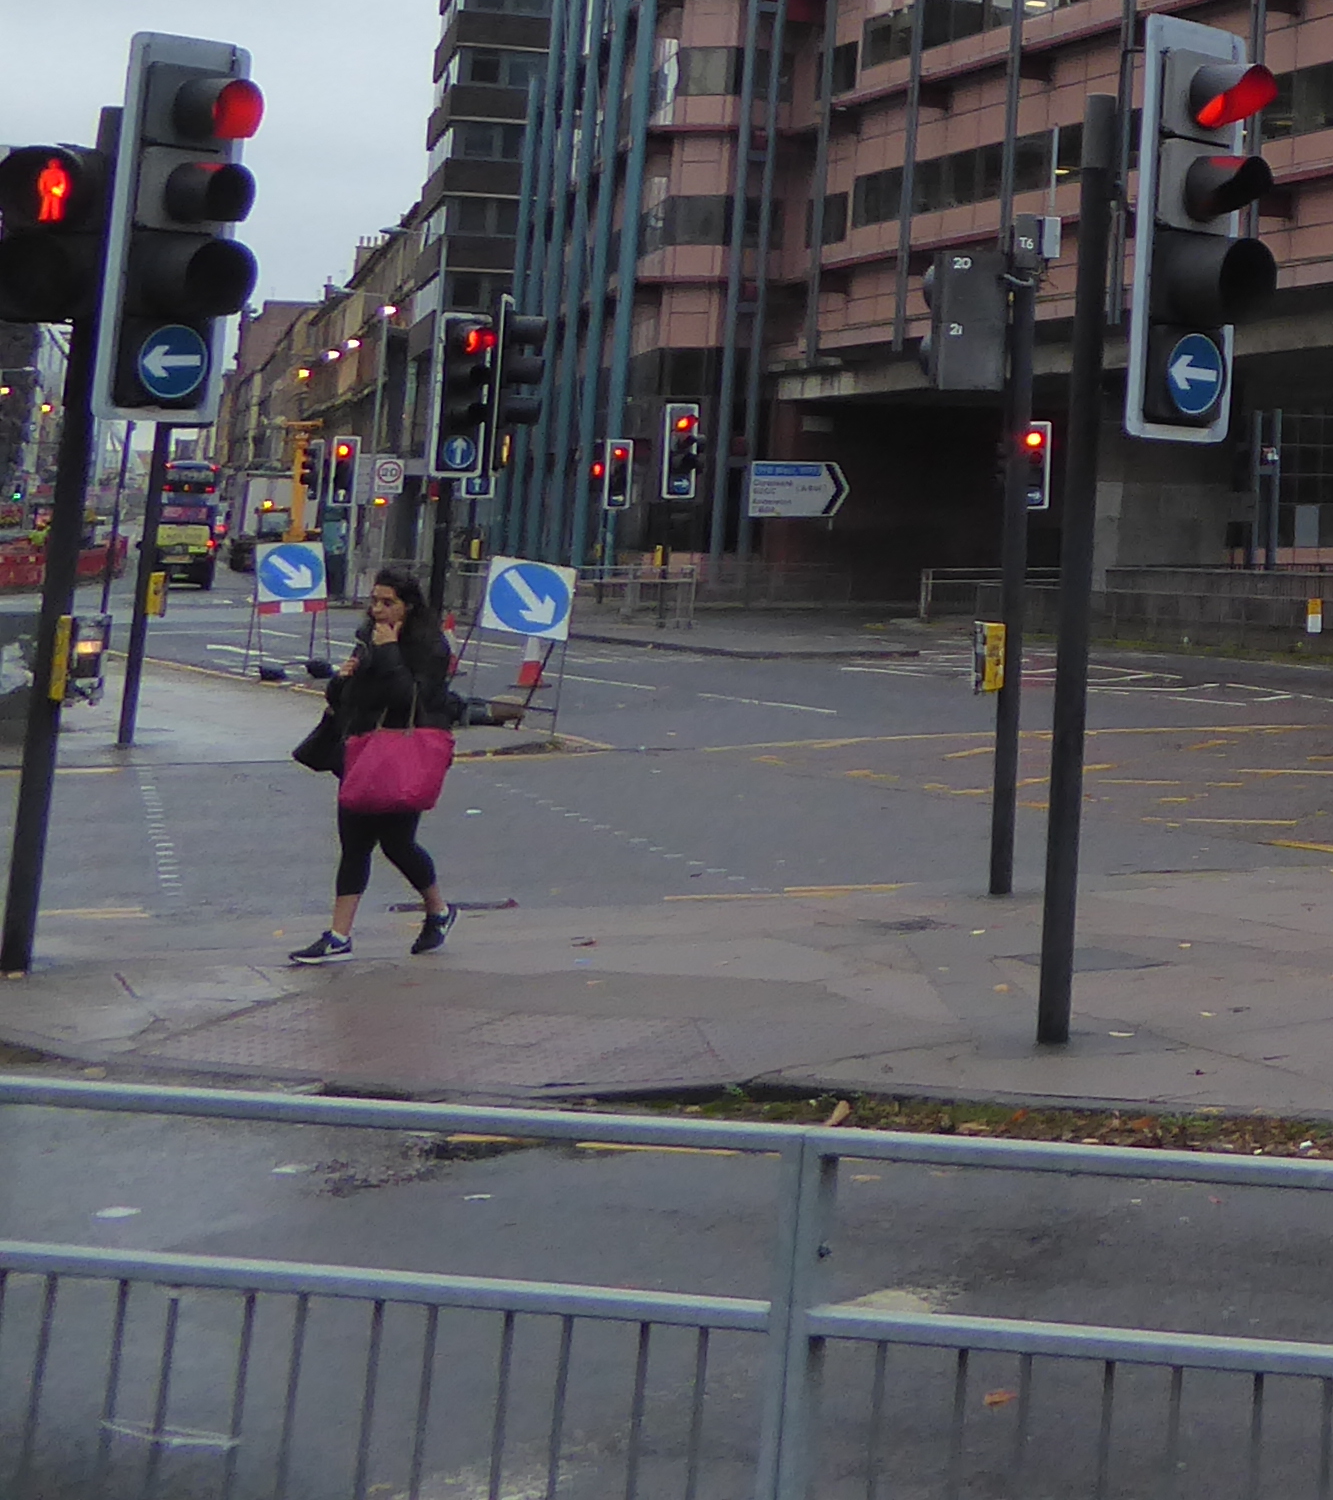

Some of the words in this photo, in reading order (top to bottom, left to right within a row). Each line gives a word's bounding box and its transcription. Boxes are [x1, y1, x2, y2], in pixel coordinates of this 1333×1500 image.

[1018, 236, 1035, 250] T6
[952, 256, 973, 270] 20
[948, 322, 964, 336] 21
